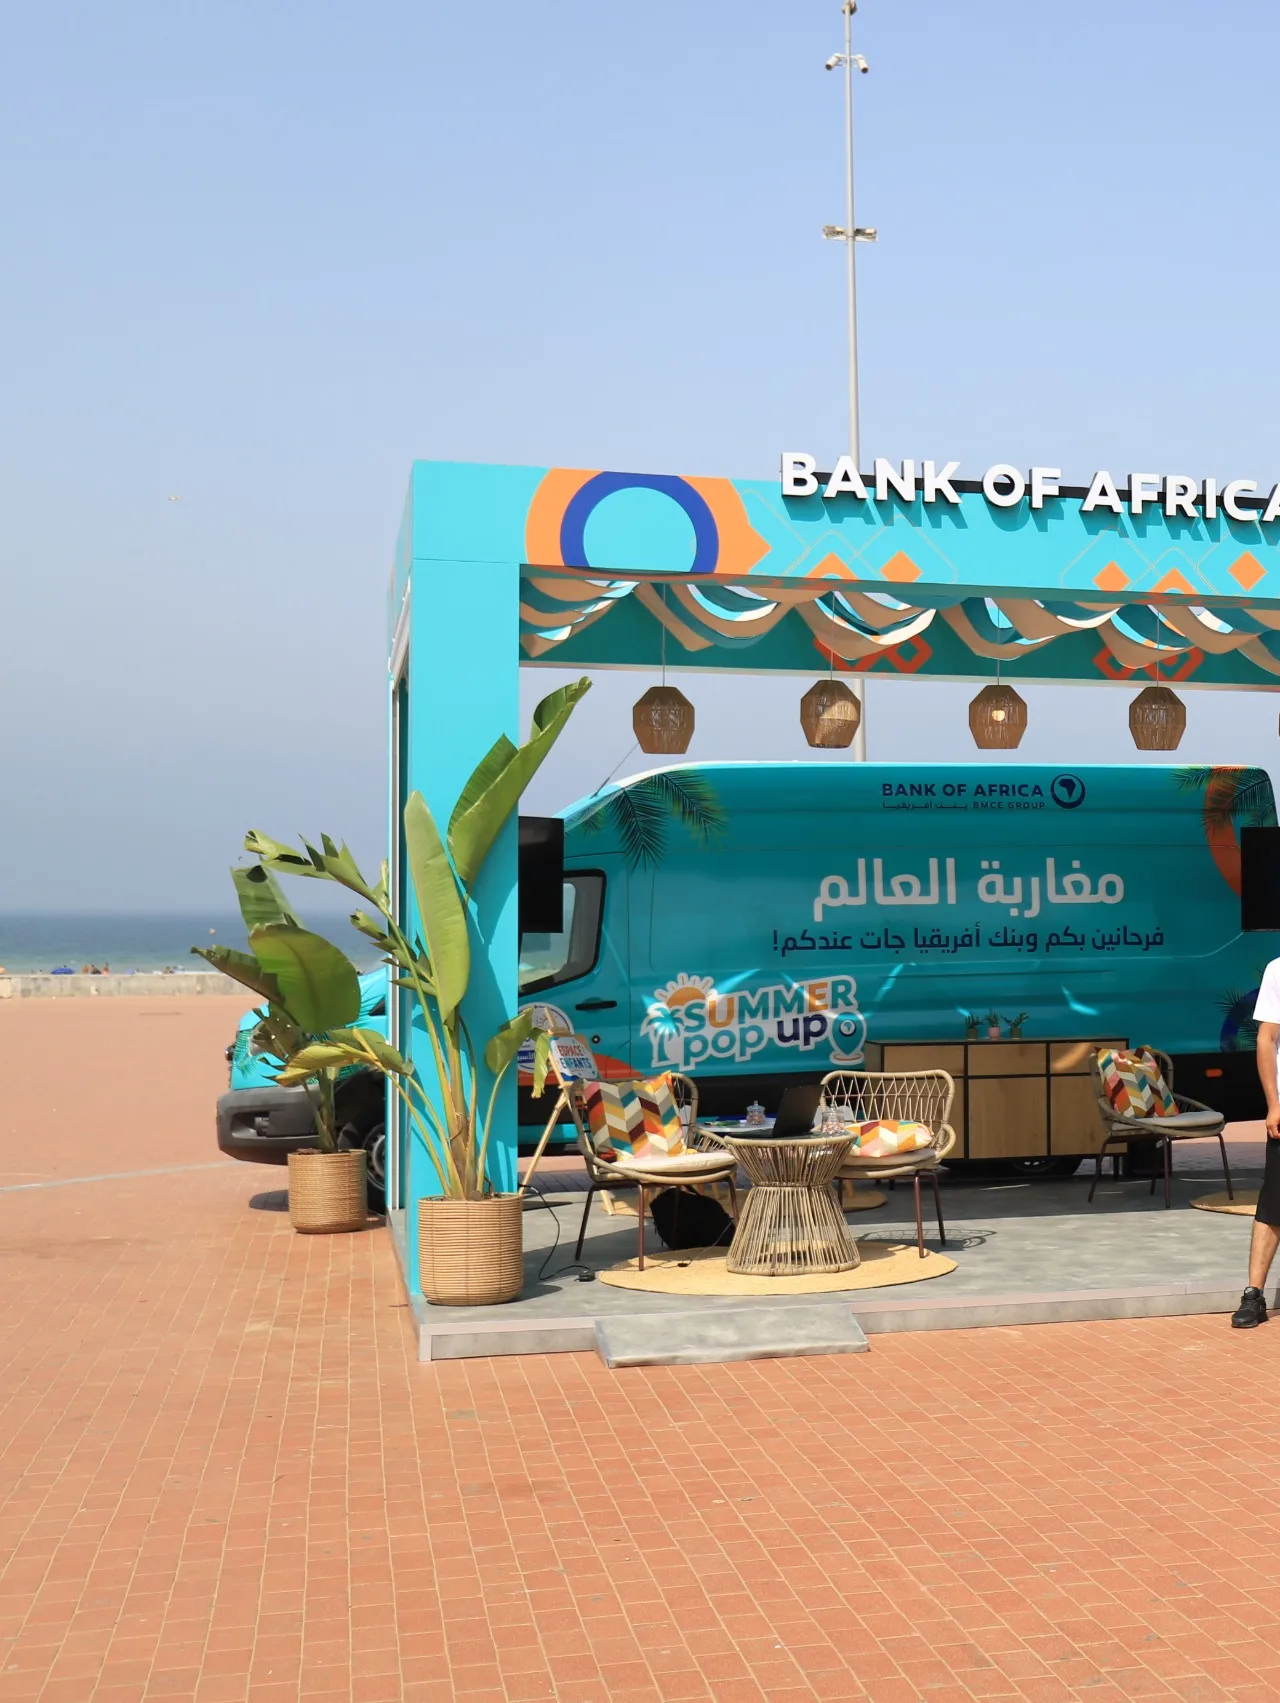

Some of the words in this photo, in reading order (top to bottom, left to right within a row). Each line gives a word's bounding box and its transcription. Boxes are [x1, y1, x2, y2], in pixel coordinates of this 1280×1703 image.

[780, 451, 963, 505] BANK
[981, 463, 1062, 509] OF
[881, 783, 937, 797] BANK
[942, 783, 967, 797] OF
[973, 783, 1044, 798] AFRICA
[973, 801, 1003, 809] BMCE
[1007, 801, 1045, 809] GROUP
[813, 857, 957, 922] العالم
[977, 857, 1125, 918] مغاربة
[860, 927, 906, 954] جات
[913, 921, 981, 954] أفريقيا
[988, 926, 1038, 952] وبنك
[1045, 925, 1086, 953] بكم
[1091, 925, 1164, 951] فرحانين
[683, 979, 855, 1034] SUMMER
[557, 1045, 585, 1057] ESPACE
[683, 1024, 765, 1067] pop
[777, 1013, 828, 1047] up
[560, 1057, 593, 1069] ENFANTS
